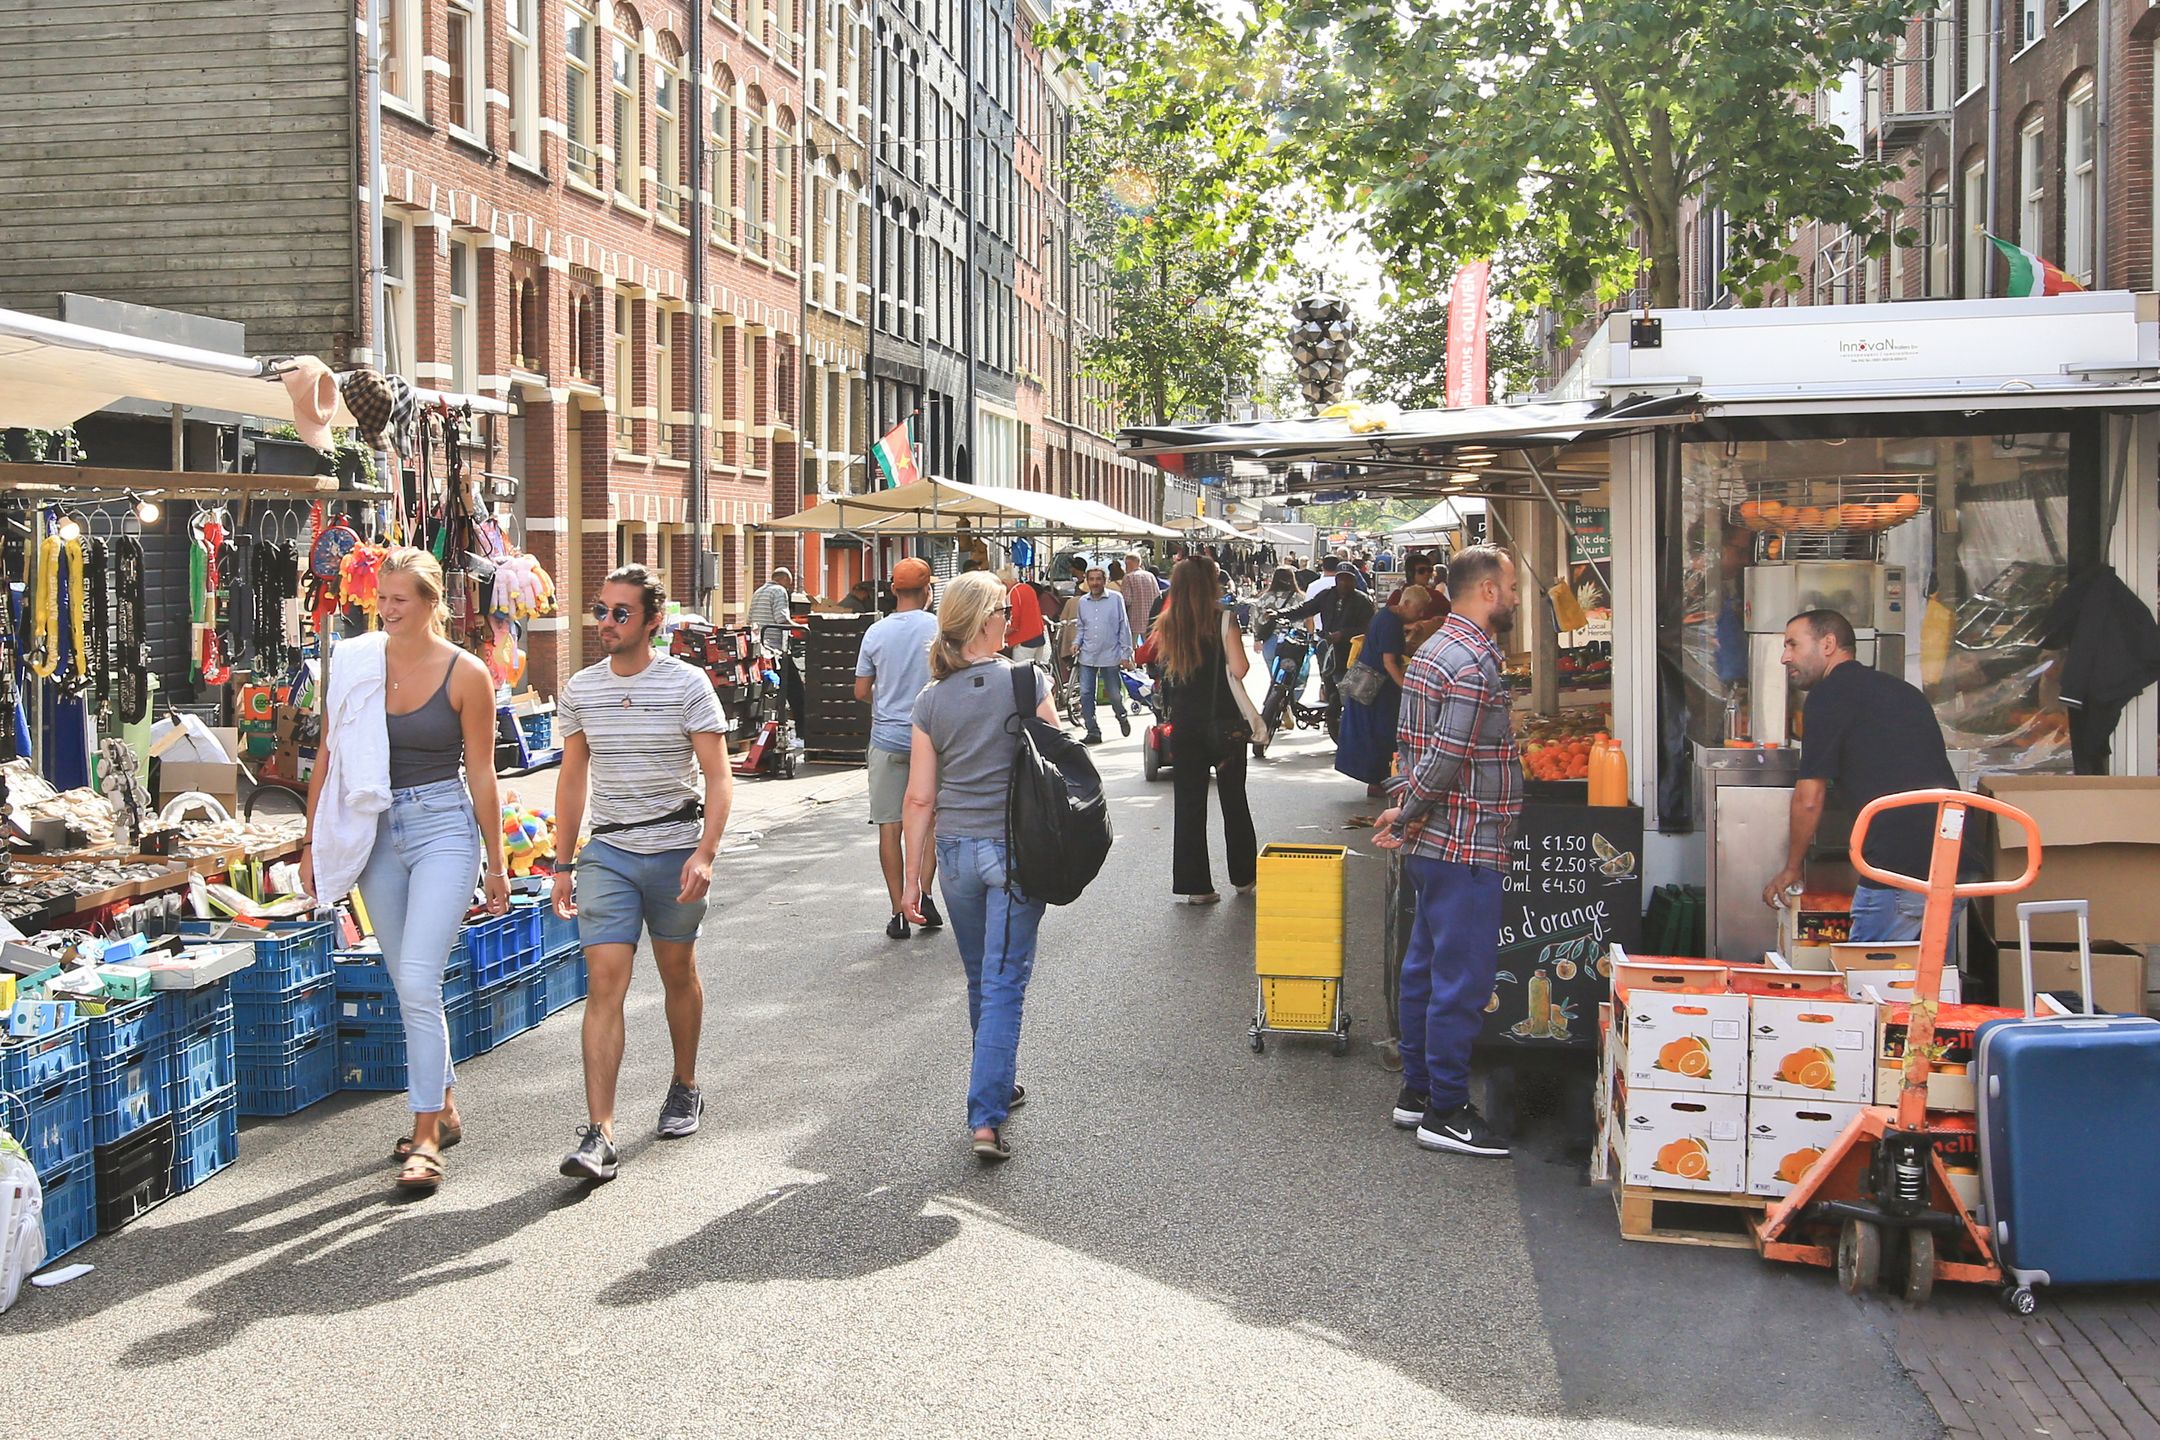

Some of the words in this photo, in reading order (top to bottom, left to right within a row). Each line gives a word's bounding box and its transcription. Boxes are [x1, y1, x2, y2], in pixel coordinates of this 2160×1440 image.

[1461, 273, 1475, 331] OLIJVEN
[1575, 515, 1593, 524] het
[82, 577, 91, 622] MAXWEB
[1541, 835, 1586, 852] €1.50
[1541, 878, 1586, 894] €4.50
[1522, 900, 1610, 942] d'orange
